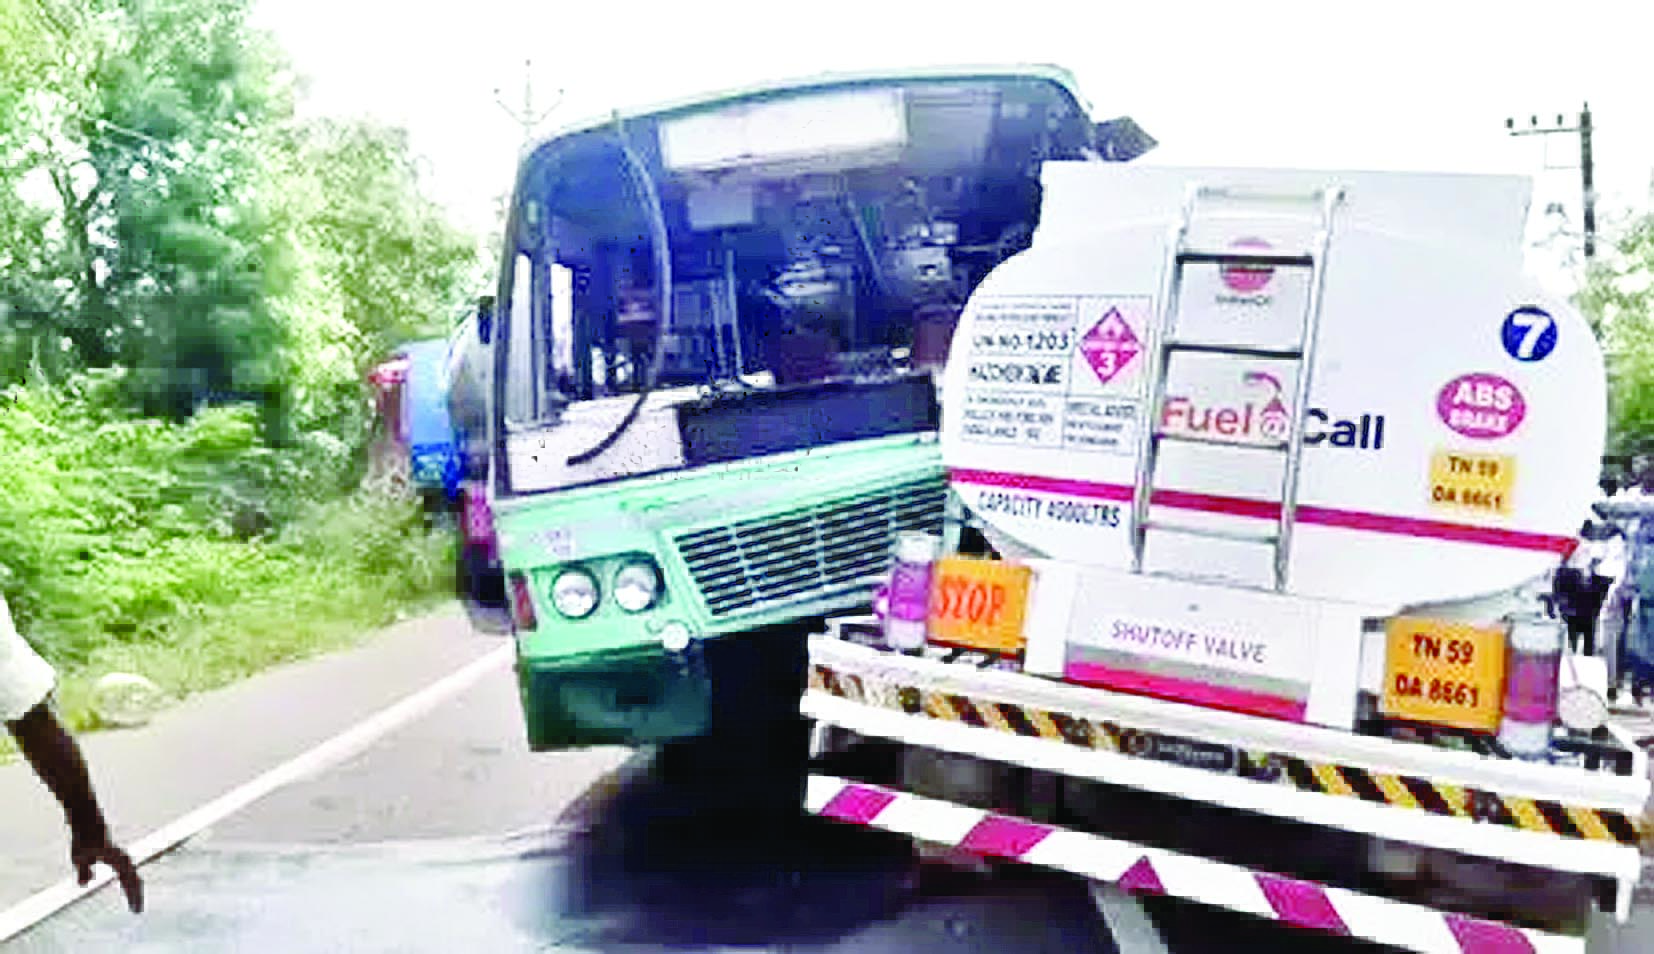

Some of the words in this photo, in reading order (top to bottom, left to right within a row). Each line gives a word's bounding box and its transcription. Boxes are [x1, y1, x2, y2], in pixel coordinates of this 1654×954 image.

[1512, 313, 1550, 358] 7
[1098, 352, 1117, 373] 3
[1453, 382, 1513, 411] ABS
[1161, 397, 1252, 435] Fuel
[1303, 408, 1384, 449] Call
[1448, 456, 1471, 473] TN
[977, 490, 1042, 519] CAPACITY
[936, 576, 1006, 627] STOP
[1112, 619, 1198, 651] SHUTOFF
[1204, 635, 1268, 663] VALVE
[1413, 633, 1441, 658] TN
[1447, 640, 1474, 664] 59
